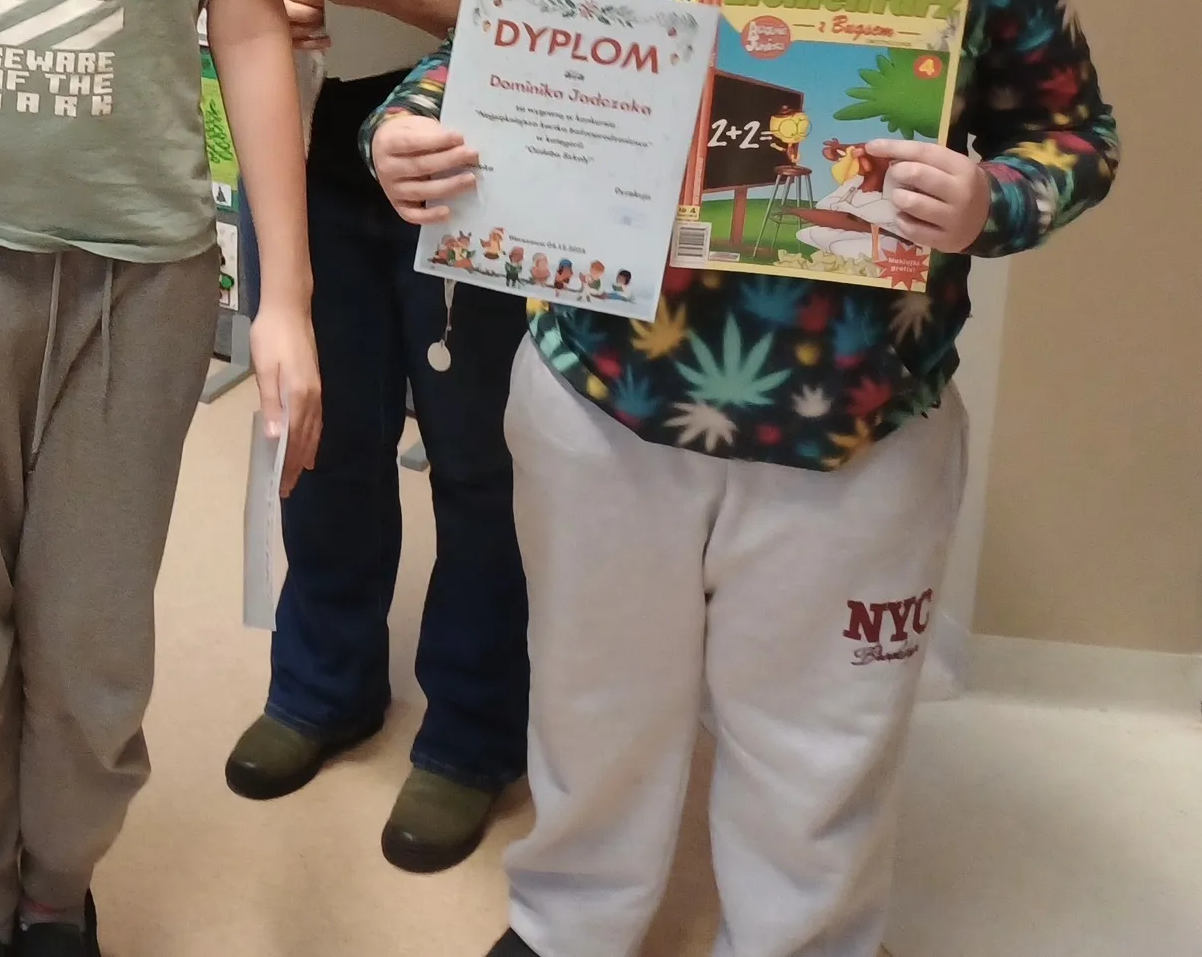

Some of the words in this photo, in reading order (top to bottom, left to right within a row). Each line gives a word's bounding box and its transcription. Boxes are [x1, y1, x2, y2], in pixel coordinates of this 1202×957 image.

[831, 14, 896, 41] Bugsem
[493, 18, 660, 75] DYPLOM
[919, 58, 935, 75] 4
[45, 71, 114, 95] THE
[489, 73, 564, 100] Dominika
[842, 588, 933, 643] NYC
